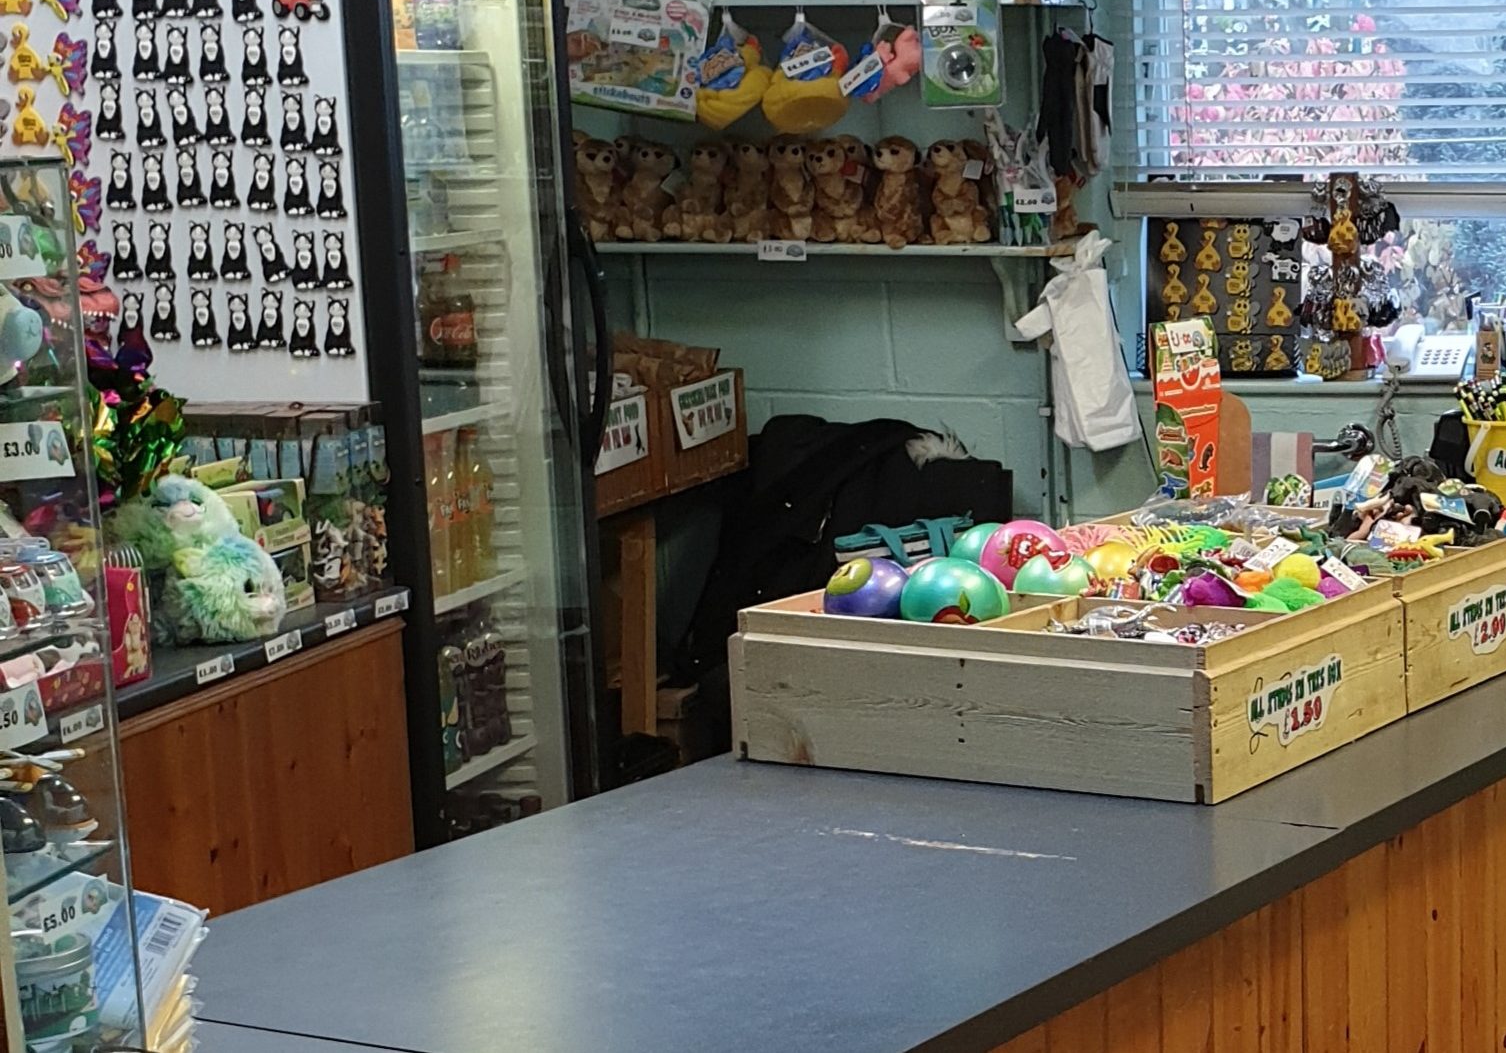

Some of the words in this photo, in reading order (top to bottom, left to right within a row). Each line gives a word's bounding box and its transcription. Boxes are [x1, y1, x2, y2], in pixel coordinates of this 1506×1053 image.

[1449, 610, 1461, 634] ALL
[1484, 595, 1494, 617] IN
[1472, 612, 1506, 648] £2.00
[1250, 696, 1266, 723] ALL
[1294, 676, 1306, 702] IN
[1306, 666, 1325, 696] THIS
[1327, 658, 1343, 687] BOX
[1282, 695, 1323, 740] £1.50
[42, 904, 77, 933] £5.00
